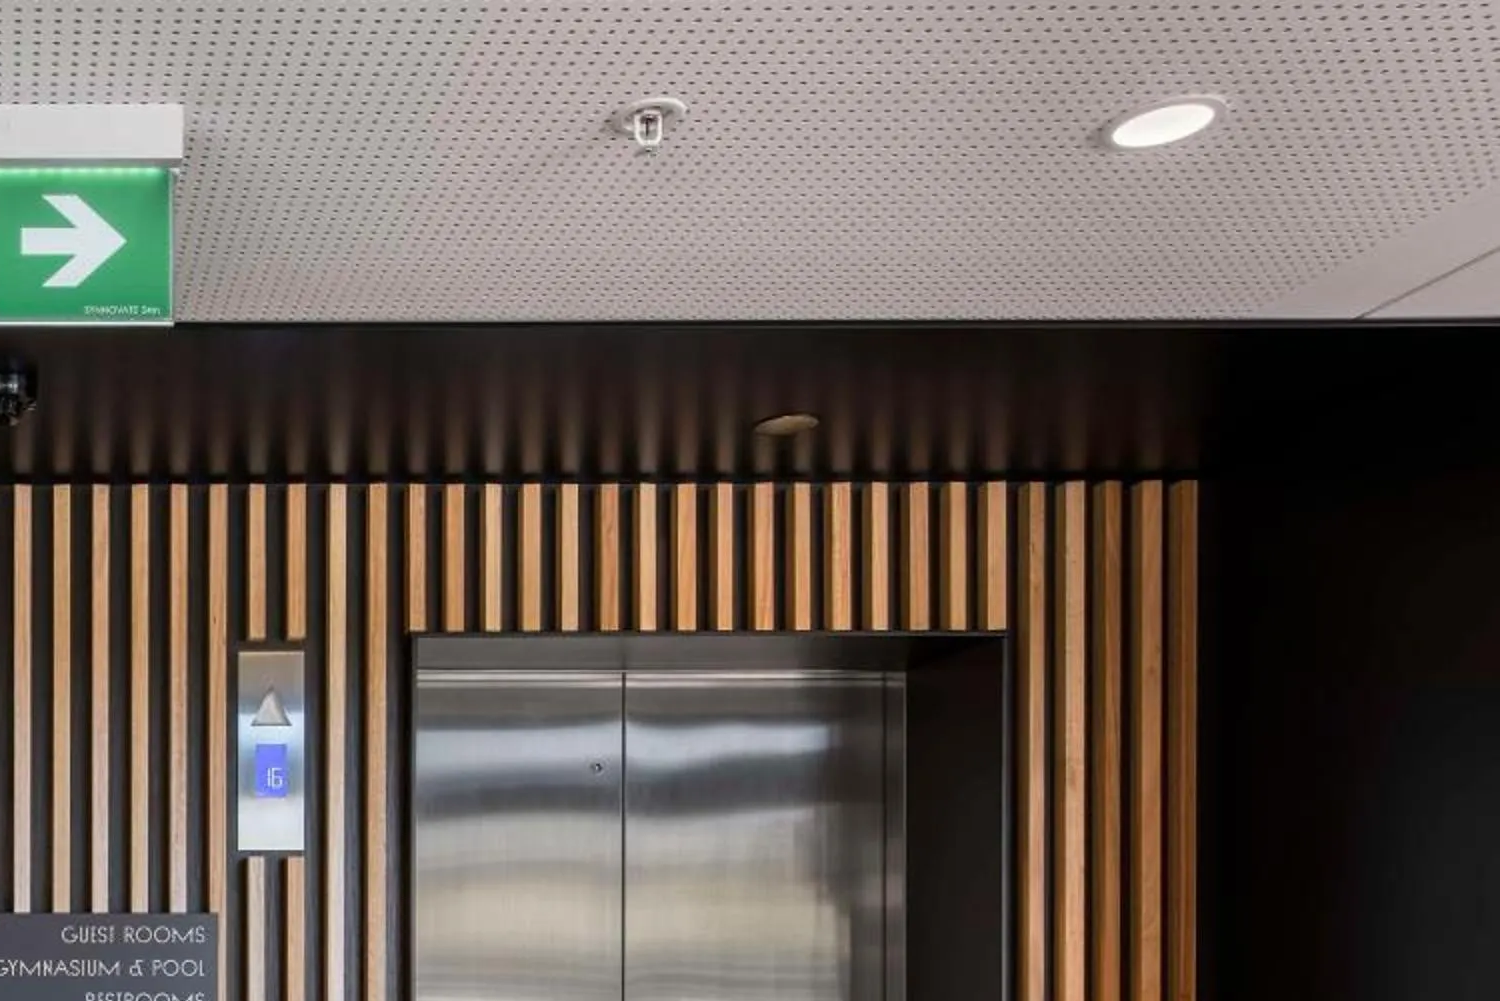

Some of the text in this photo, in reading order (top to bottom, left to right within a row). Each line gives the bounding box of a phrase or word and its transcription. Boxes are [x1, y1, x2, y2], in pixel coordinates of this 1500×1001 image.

[266, 767, 283, 789] 16
[61, 926, 206, 943] GUEST ROOMS
[129, 960, 144, 976] &
[152, 959, 205, 976] POOL
